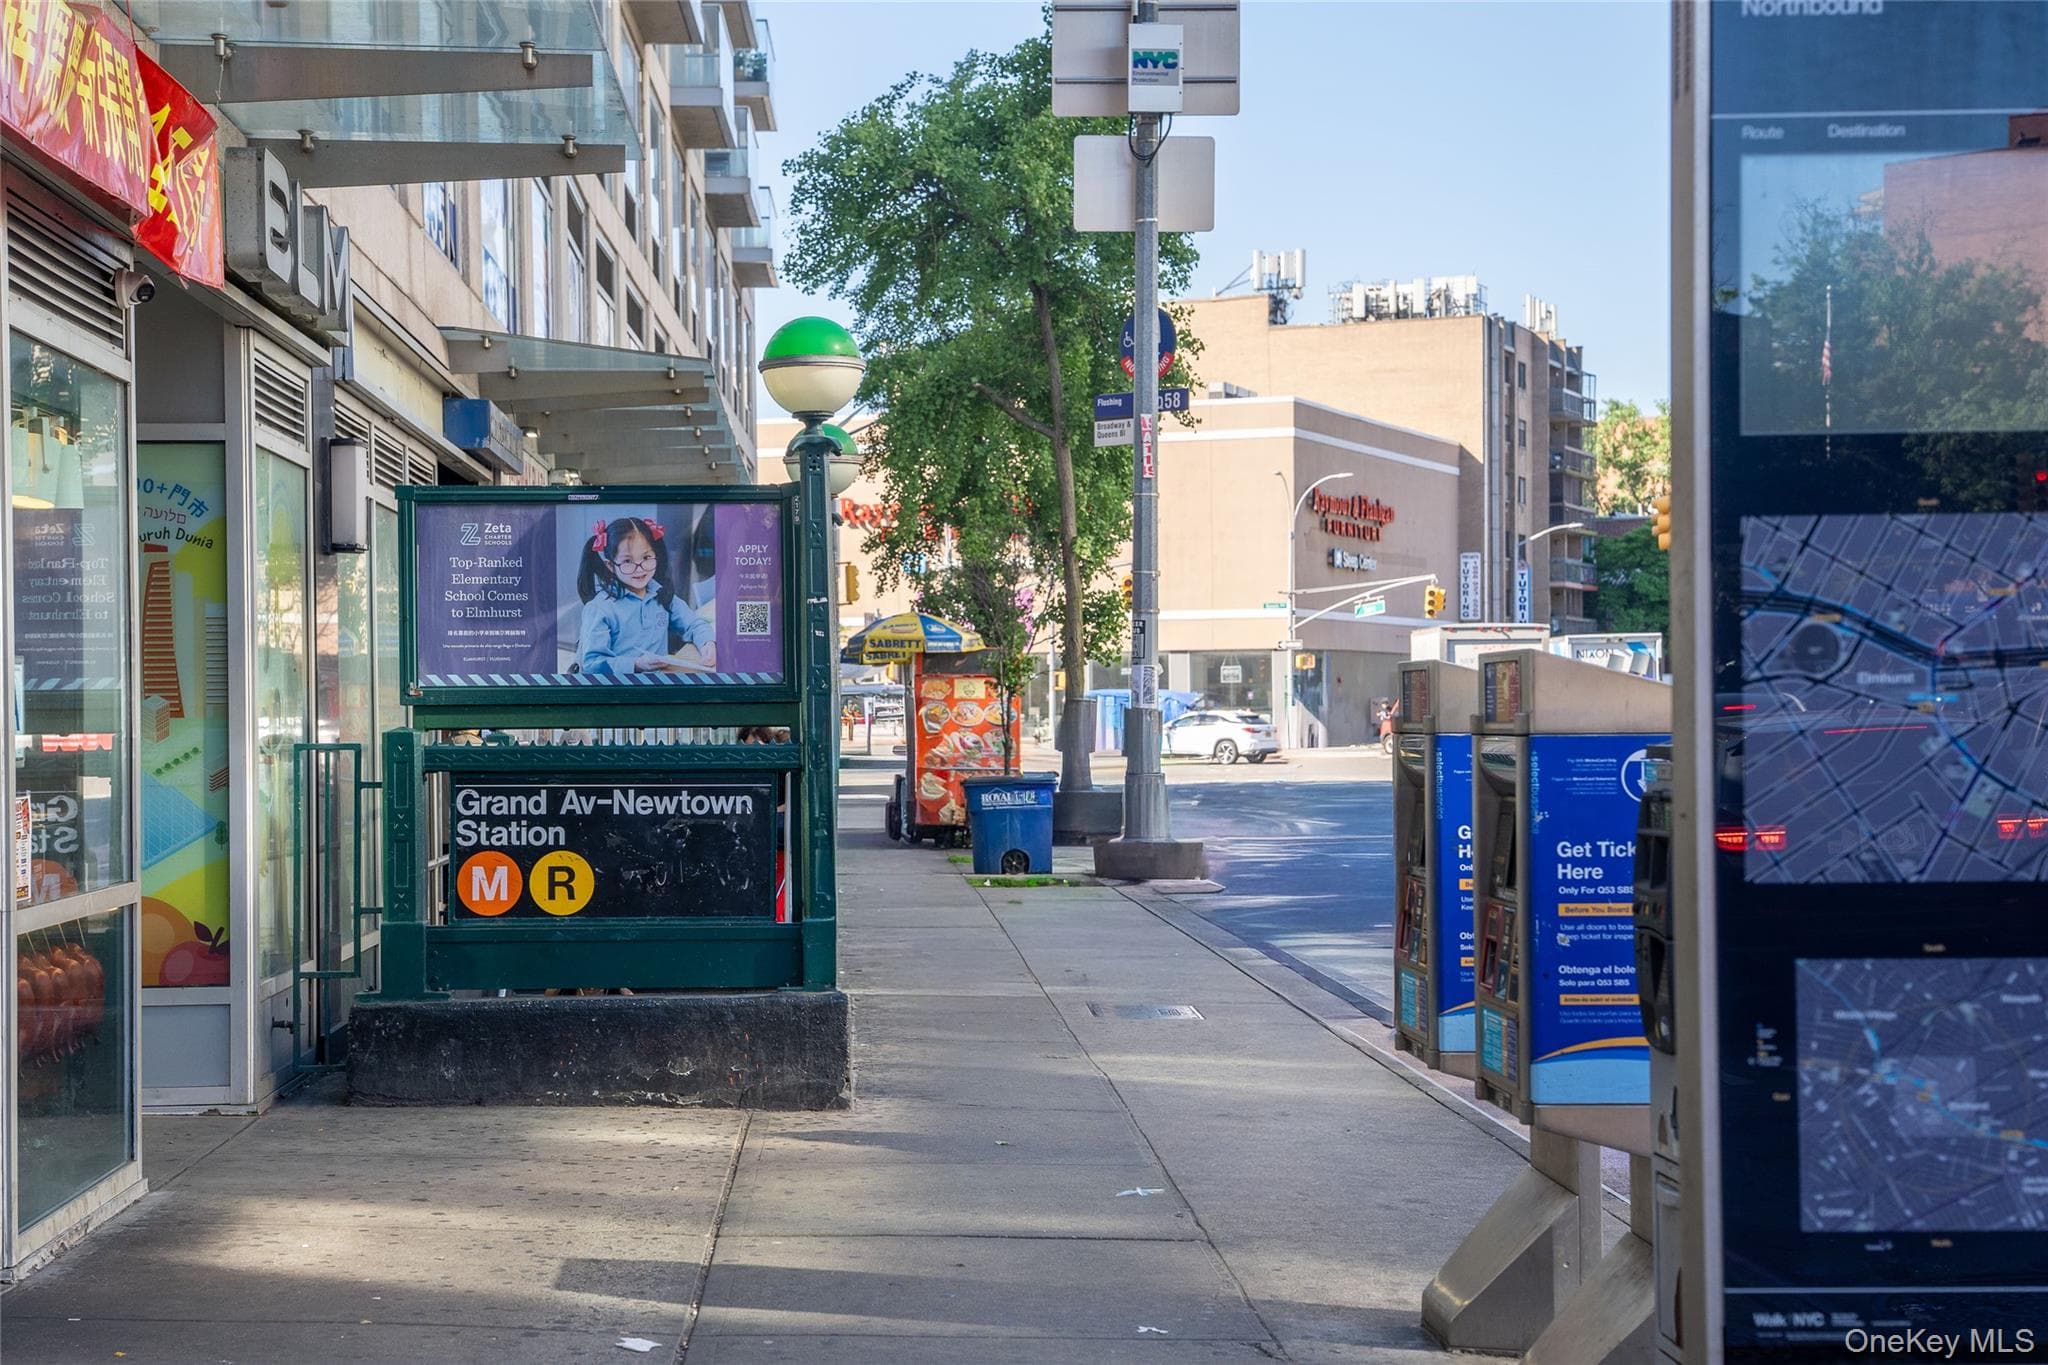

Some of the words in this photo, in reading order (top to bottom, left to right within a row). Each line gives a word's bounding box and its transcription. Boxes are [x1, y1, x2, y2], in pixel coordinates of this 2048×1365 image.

[1132, 50, 1178, 69] NYC
[1827, 123, 1906, 138] Destination
[1096, 398, 1123, 408] Flushing
[1096, 421, 1125, 431] Broadway
[484, 523, 512, 533] Zeta
[175, 527, 214, 549] Dunia
[737, 544, 769, 553] APPLY
[449, 556, 523, 570] Top-Ranked
[734, 557, 772, 566] TODAY!
[451, 573, 522, 586] Elementary
[445, 589, 485, 601] School
[487, 590, 529, 601] Comes
[451, 607, 464, 618] to
[465, 606, 523, 618] Elmhurst
[869, 638, 923, 649] SABRETT
[456, 789, 547, 816] Grand
[560, 788, 753, 816] Av-Newtown
[455, 819, 566, 846] Station
[1556, 841, 1593, 859] Get
[1557, 863, 1605, 880] Here
[471, 865, 509, 900] M
[547, 865, 577, 900] R
[1558, 886, 1580, 896] Only
[1581, 886, 1597, 895] For
[1597, 886, 1616, 895] Q53
[1587, 924, 1608, 932] doors
[1558, 965, 1601, 977] Obtenga
[1603, 965, 1613, 974] el
[1558, 979, 1577, 987] Solo
[1577, 979, 1596, 988] para
[1596, 978, 1613, 987] Q53
[1613, 979, 1631, 987] SBS
